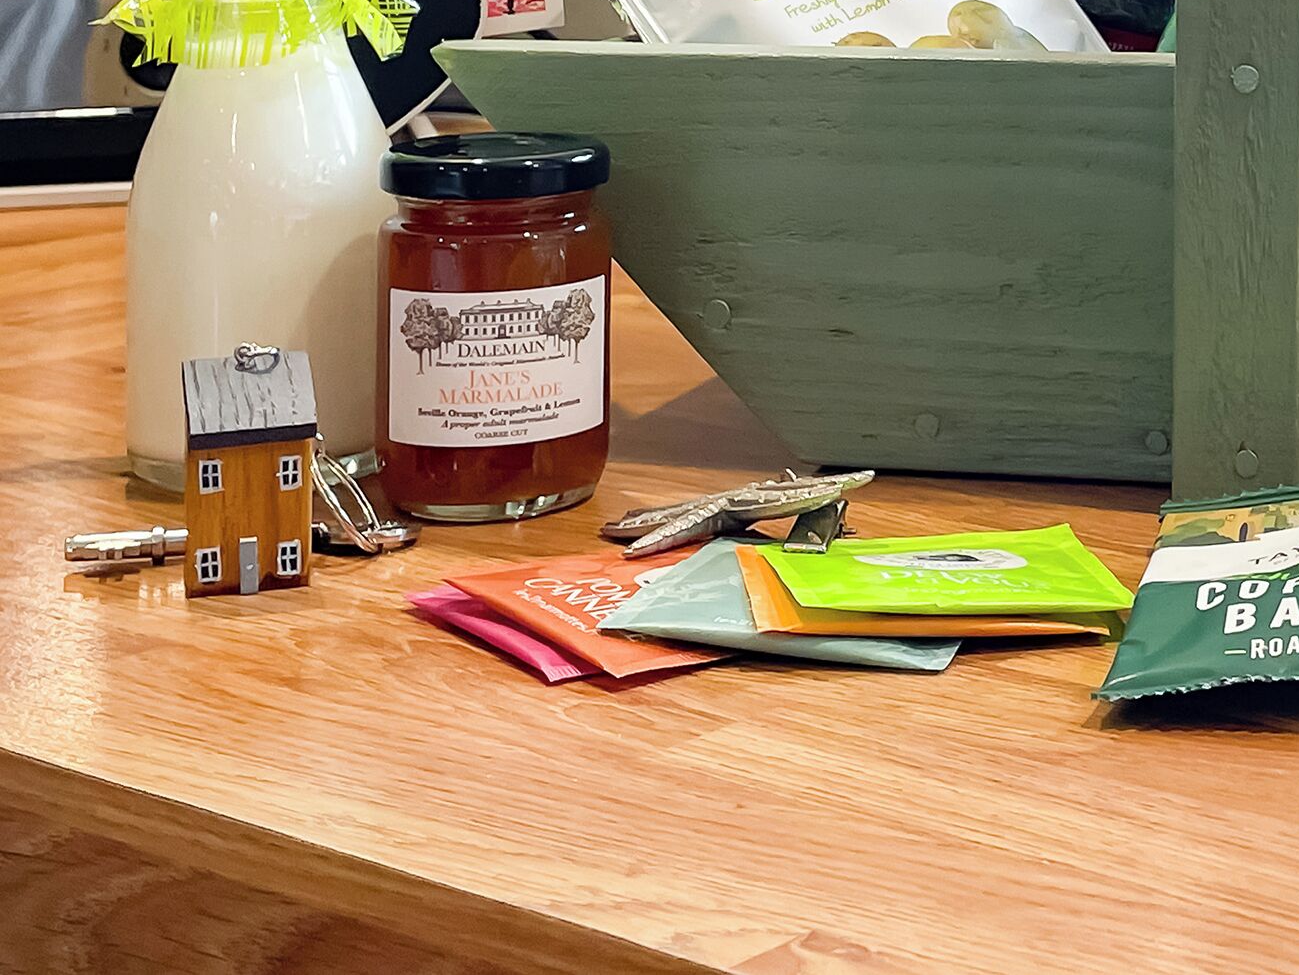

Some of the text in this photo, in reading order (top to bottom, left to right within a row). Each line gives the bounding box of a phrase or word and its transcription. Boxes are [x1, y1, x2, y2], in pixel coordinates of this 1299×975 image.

[811, 16, 843, 33] with
[458, 340, 546, 358] DALEMAIN
[465, 369, 531, 390] JANE'S
[439, 382, 563, 405] MARMALADE
[448, 409, 487, 419] Orange,
[490, 404, 542, 417] Grapefruit
[544, 402, 551, 410] &
[553, 398, 580, 409] Lemon
[441, 420, 448, 428] A
[450, 421, 481, 430] proper
[510, 428, 528, 437] CUT
